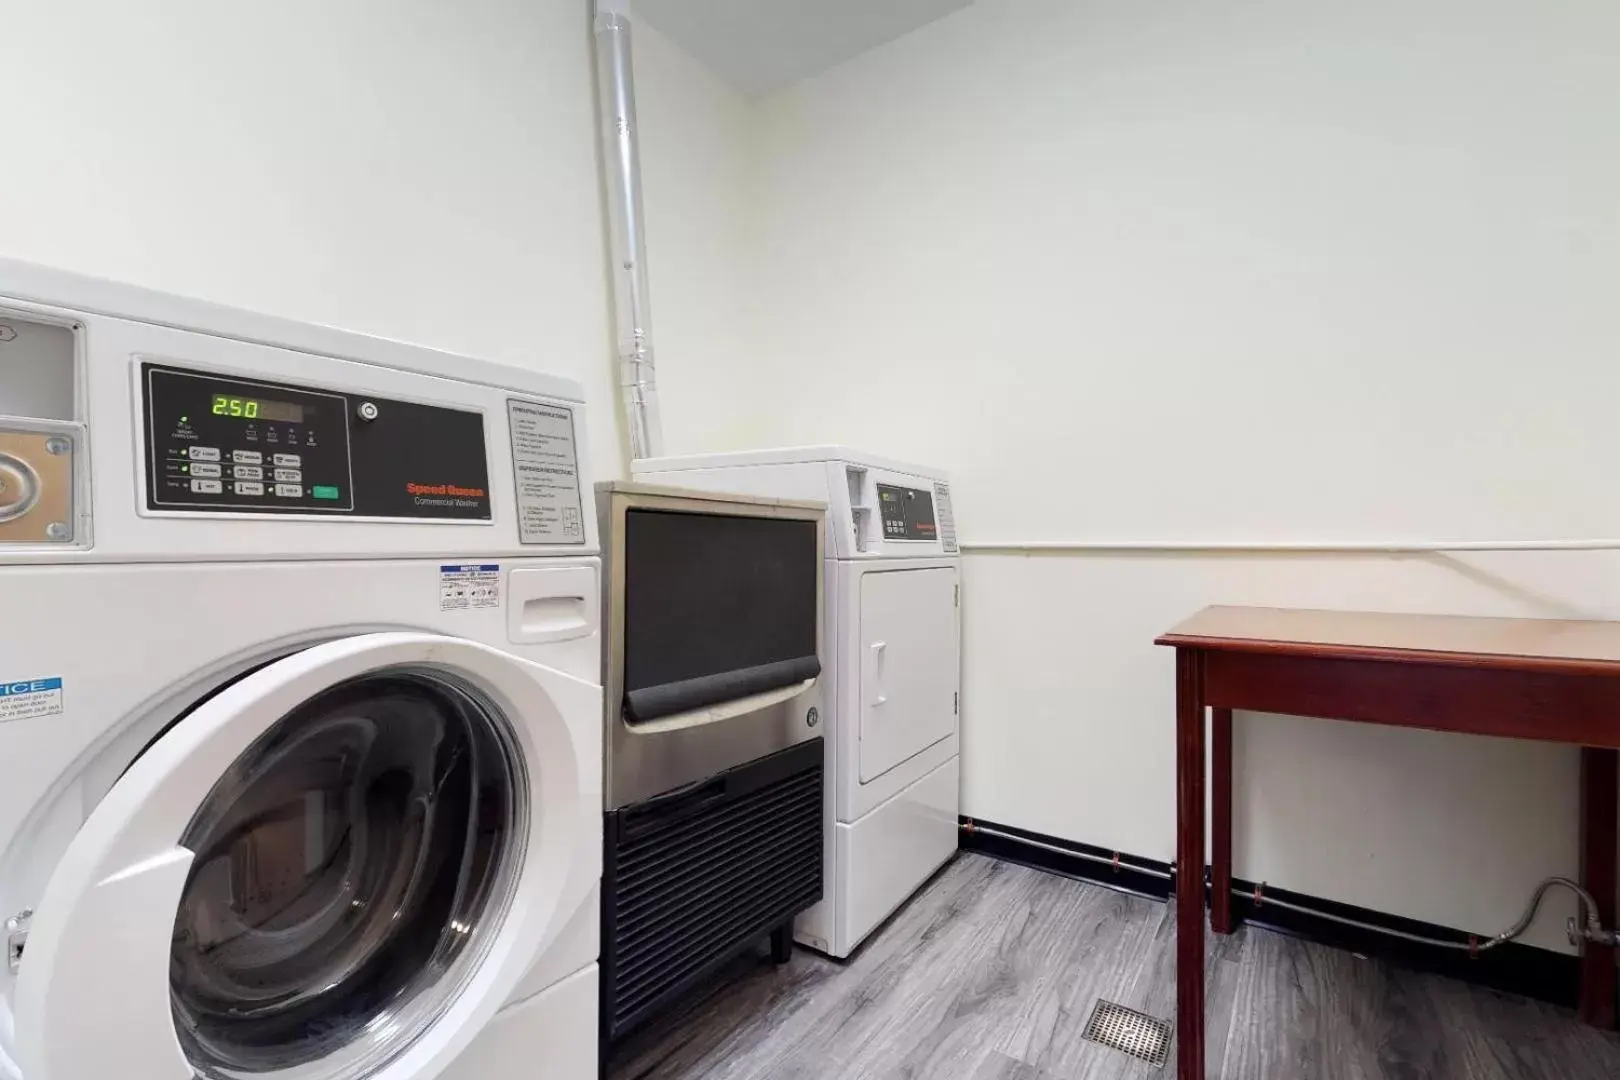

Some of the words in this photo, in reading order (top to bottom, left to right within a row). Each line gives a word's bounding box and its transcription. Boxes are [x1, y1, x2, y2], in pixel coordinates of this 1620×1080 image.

[212, 397, 258, 418] 2.50
[406, 482, 446, 496] Speed
[447, 484, 485, 497] Queen
[414, 496, 454, 507] Commercial
[456, 498, 479, 508] Washer
